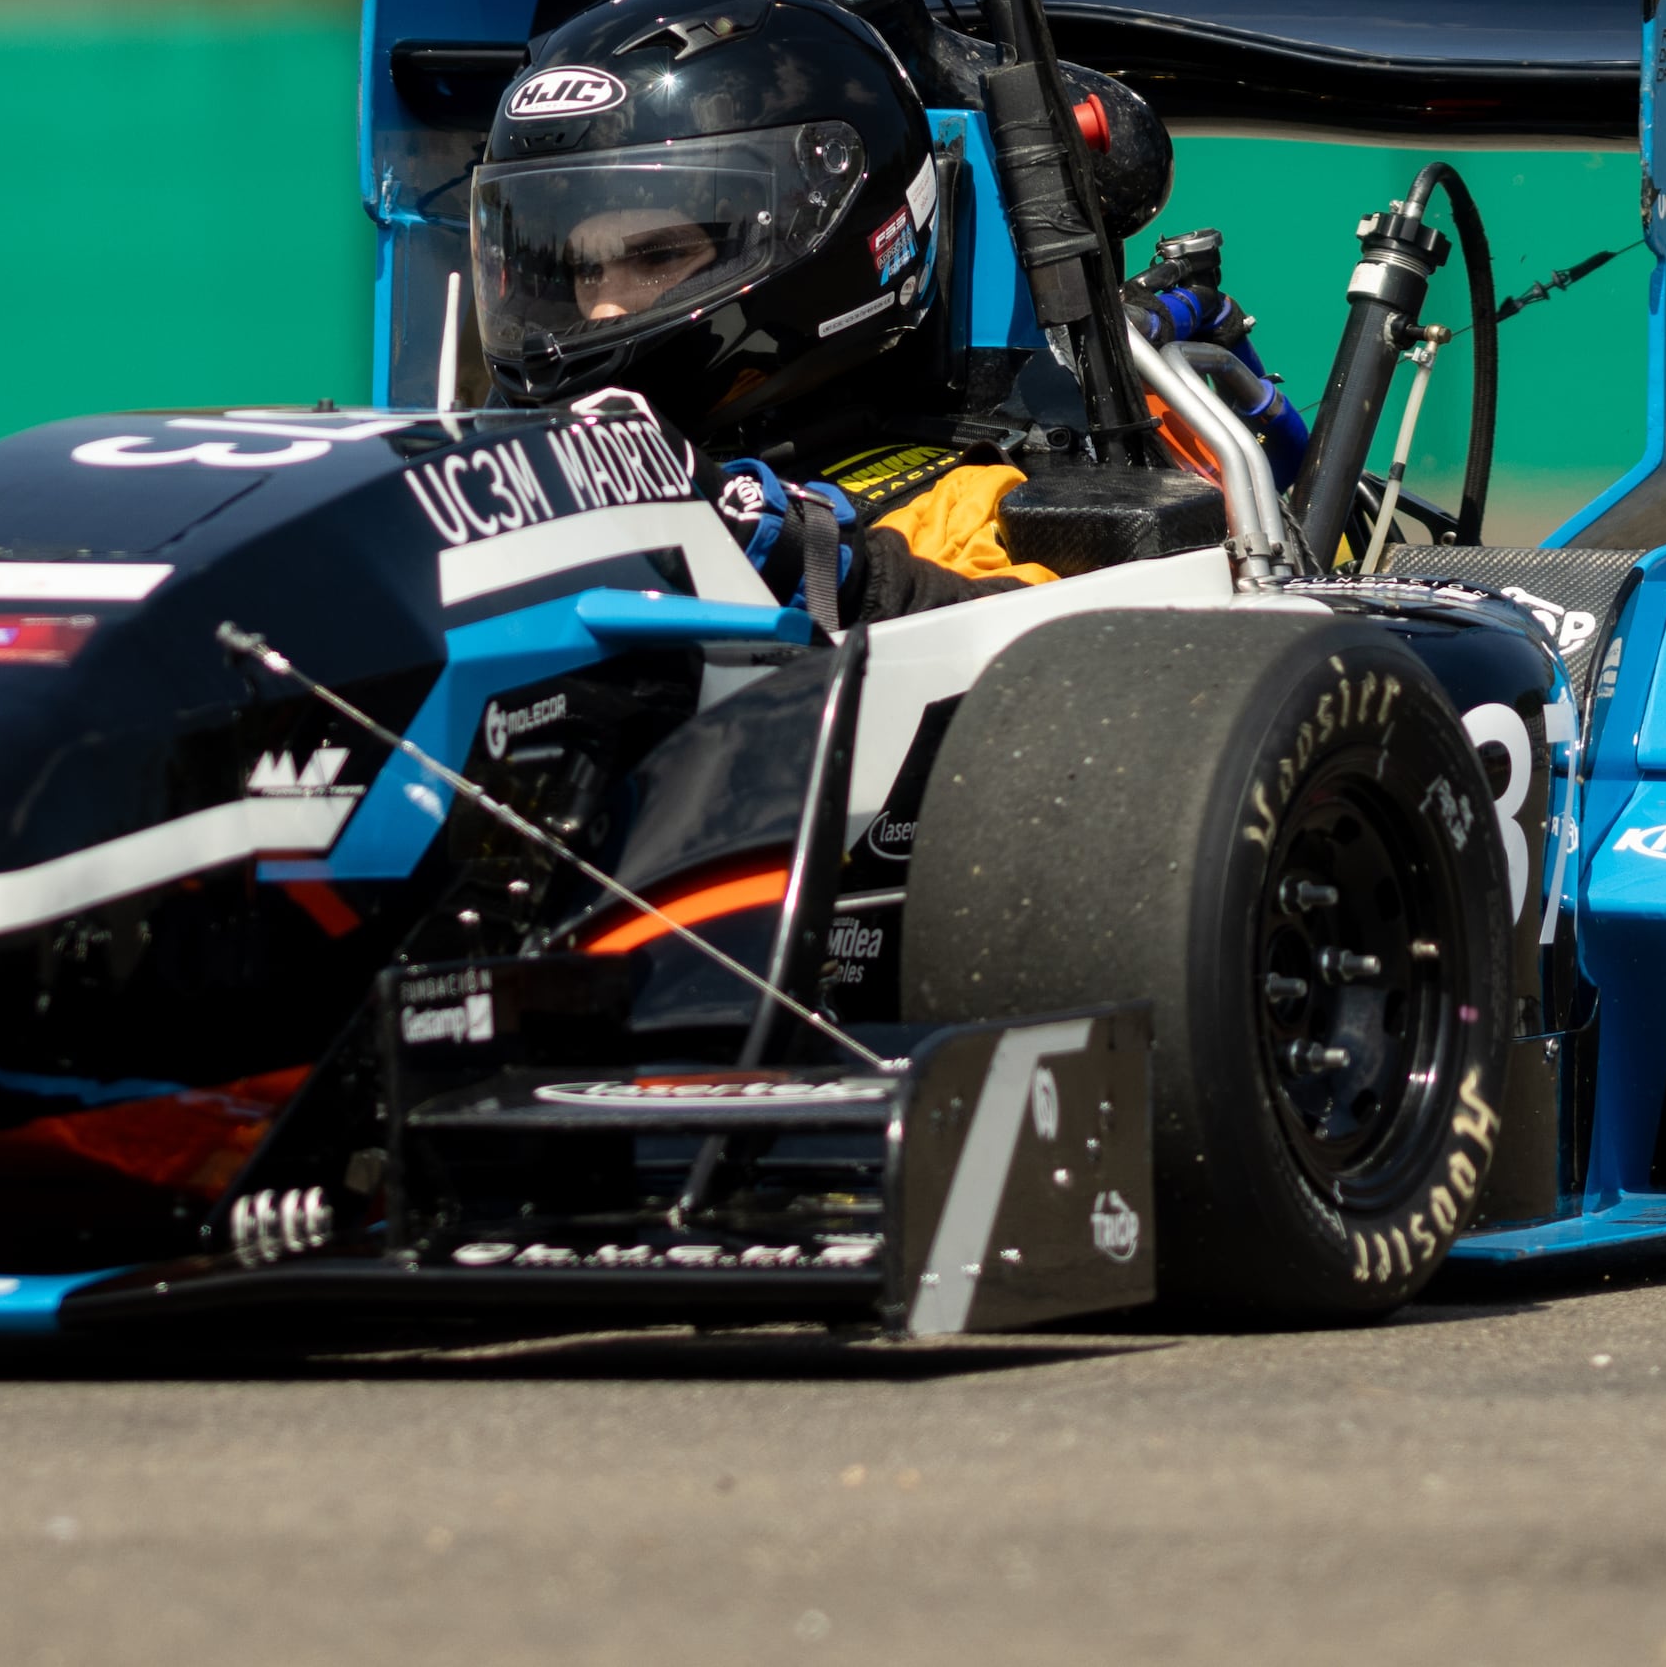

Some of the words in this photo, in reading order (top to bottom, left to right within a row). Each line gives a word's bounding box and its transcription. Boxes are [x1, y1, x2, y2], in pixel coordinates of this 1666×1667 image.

[514, 80, 607, 108] HJC
[404, 439, 554, 545] UC3M
[547, 421, 691, 510] MADRID
[508, 693, 566, 738] MOLECOR
